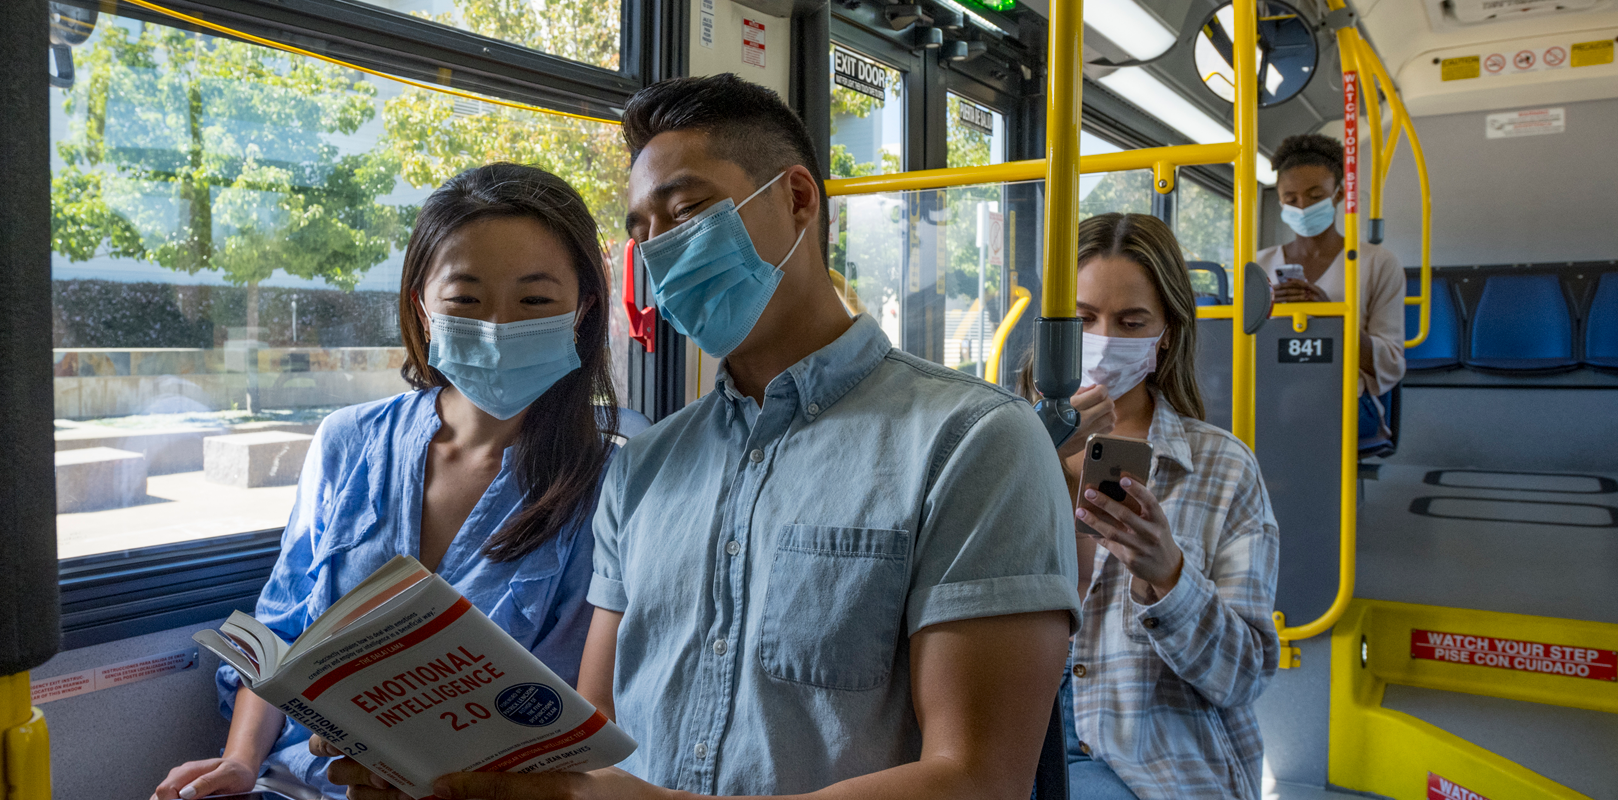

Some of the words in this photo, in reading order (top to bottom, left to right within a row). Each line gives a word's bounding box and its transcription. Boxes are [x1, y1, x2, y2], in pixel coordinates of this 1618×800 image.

[836, 51, 856, 76] EXIT
[858, 60, 885, 88] DOOR
[1344, 74, 1356, 121] WATCH
[1346, 127, 1356, 165] YOUR
[1346, 172, 1356, 210] STEP
[1288, 339, 1322, 356] 841
[383, 624, 395, 632] with
[394, 612, 418, 627] emotions
[331, 658, 341, 666] and
[398, 617, 424, 633] beneficial
[370, 648, 388, 660] DALAI
[387, 642, 405, 653] LAMA
[1427, 632, 1489, 651] WATCH
[1493, 639, 1544, 658] YOUR
[1549, 645, 1599, 663] STEP
[102, 664, 138, 674] INSTRUCCIONES
[137, 663, 167, 672] LOCALIZADAS
[1434, 648, 1470, 663] PISE
[1474, 652, 1511, 668] CON
[1513, 658, 1590, 677] CUIDADO
[31, 687, 54, 695] LOCATED
[63, 679, 89, 688] REARWARD
[61, 686, 82, 694] WINDOW
[350, 646, 486, 714] EMOTIONAL
[375, 662, 506, 728] INTELLIGENCE
[280, 704, 340, 744] INTELLIGENCE
[288, 698, 349, 741] EMOTIONAL
[440, 702, 492, 732] 2.0
[546, 707, 558, 717] TEAM
[344, 742, 368, 756] 2.0
[498, 756, 519, 767] POPULAR
[518, 747, 544, 759] EMOTIONAL
[542, 735, 575, 749] INTELLIGENCE
[573, 729, 587, 738] TEST
[545, 755, 562, 764] JEAN
[561, 745, 591, 758] GREAVES
[1440, 778, 1490, 800] WATC
